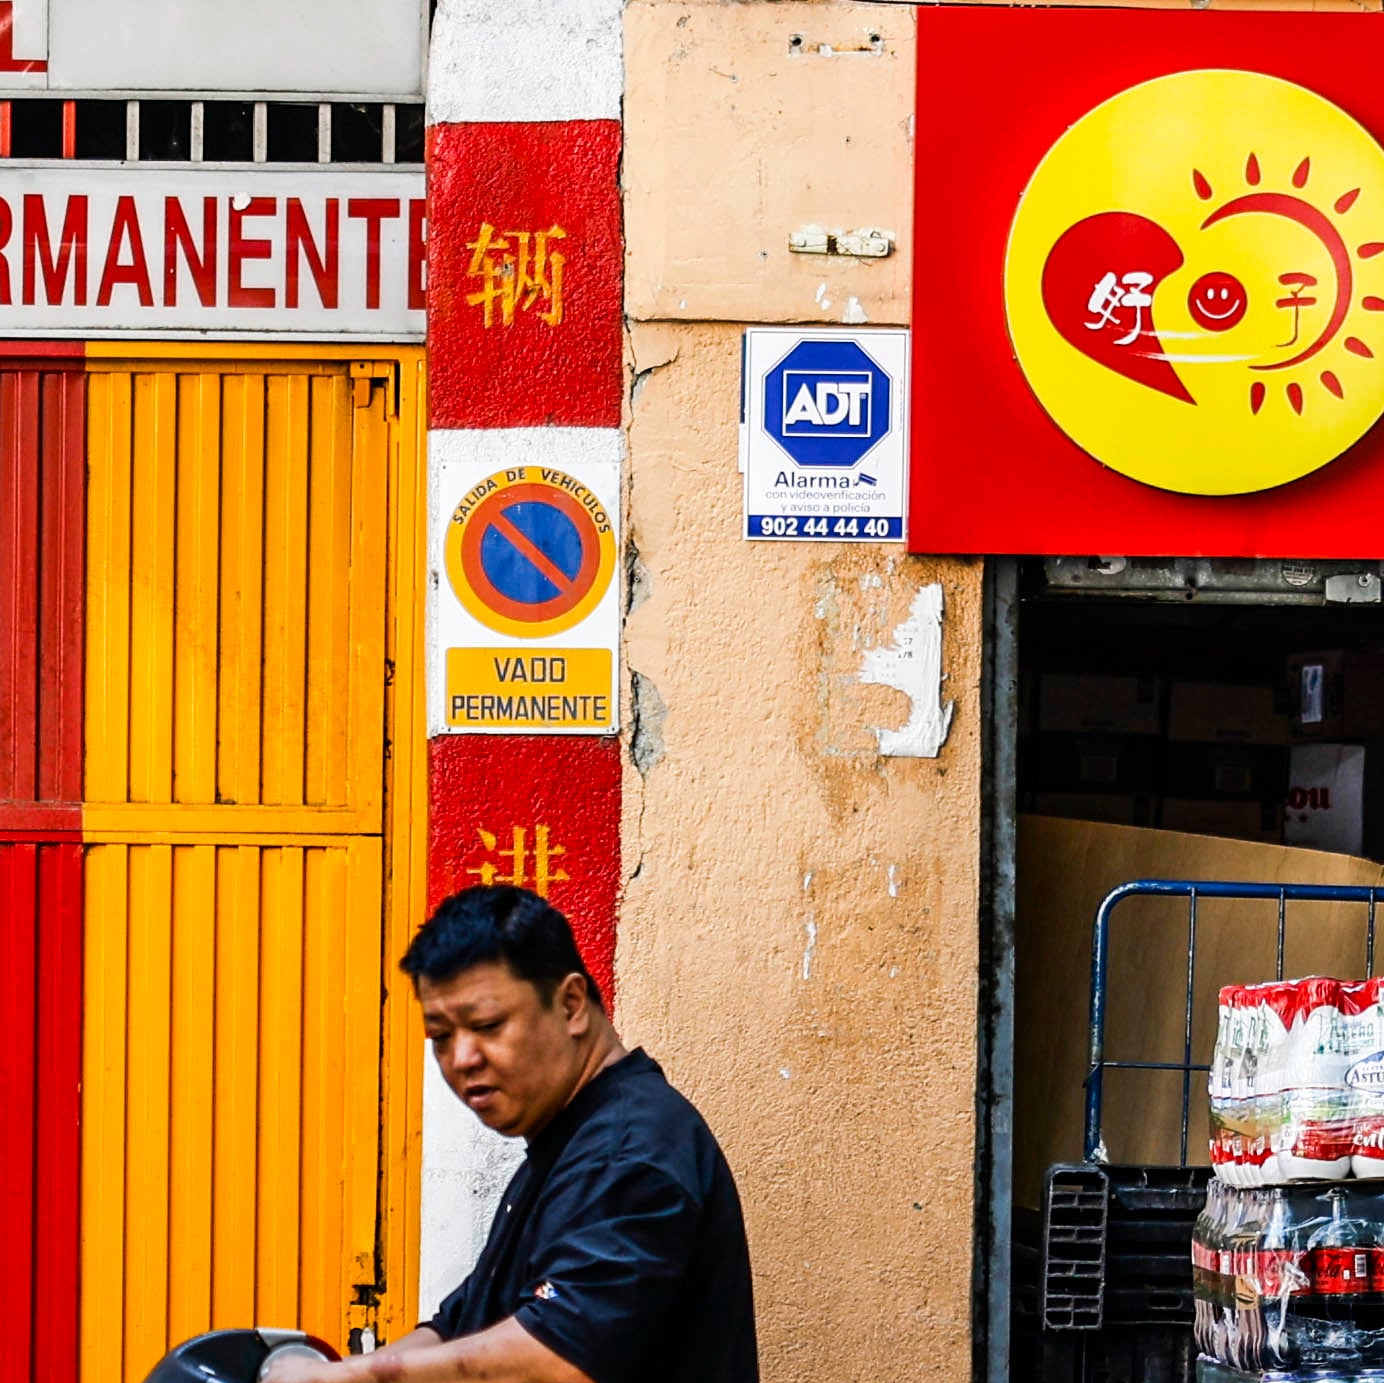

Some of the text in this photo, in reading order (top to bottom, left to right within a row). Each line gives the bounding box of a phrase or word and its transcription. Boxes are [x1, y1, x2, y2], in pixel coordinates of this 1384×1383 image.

[1084, 271, 1318, 348] 好 子
[784, 382, 871, 426] ADT
[774, 471, 851, 489] Alarma
[452, 466, 611, 534] SALIDA DE VEHICULOS
[761, 517, 889, 537] 902 44 44 40
[493, 656, 566, 683] VADO
[451, 695, 607, 721] PERMANENTE
